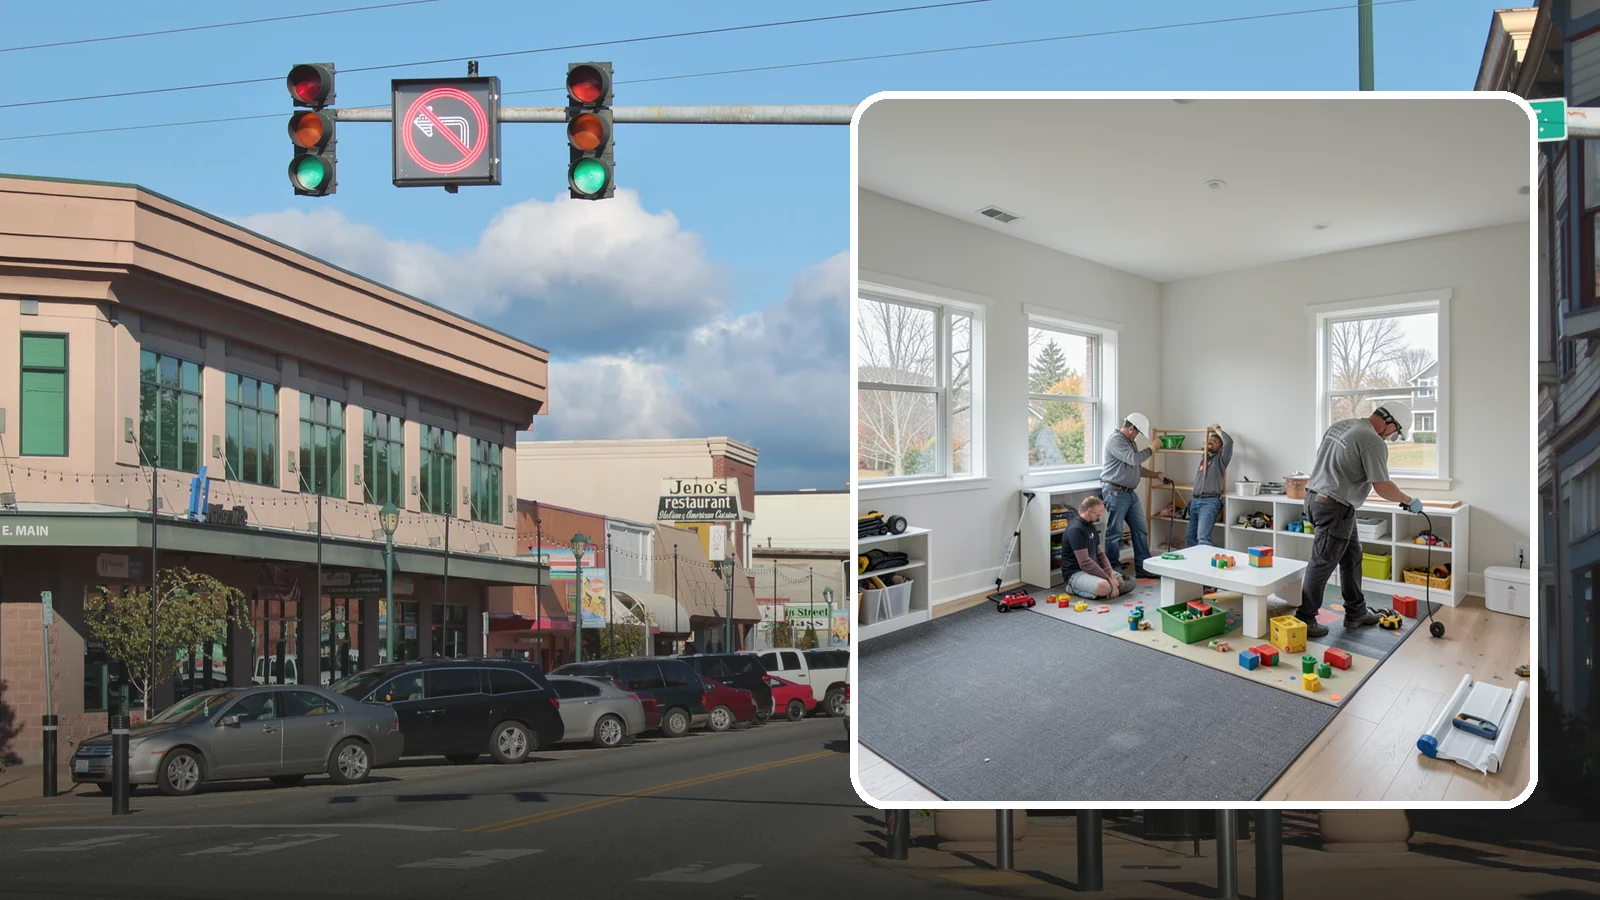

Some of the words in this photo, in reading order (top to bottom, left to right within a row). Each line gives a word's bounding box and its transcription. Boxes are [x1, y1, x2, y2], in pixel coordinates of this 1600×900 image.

[669, 480, 727, 494] Jeno's
[665, 496, 731, 509] restaurant
[658, 509, 681, 520] Italian
[686, 509, 714, 519] American
[715, 509, 737, 519] Cuisine
[2, 525, 13, 536] E.
[15, 525, 49, 536] MAIN
[797, 607, 828, 616] Street
